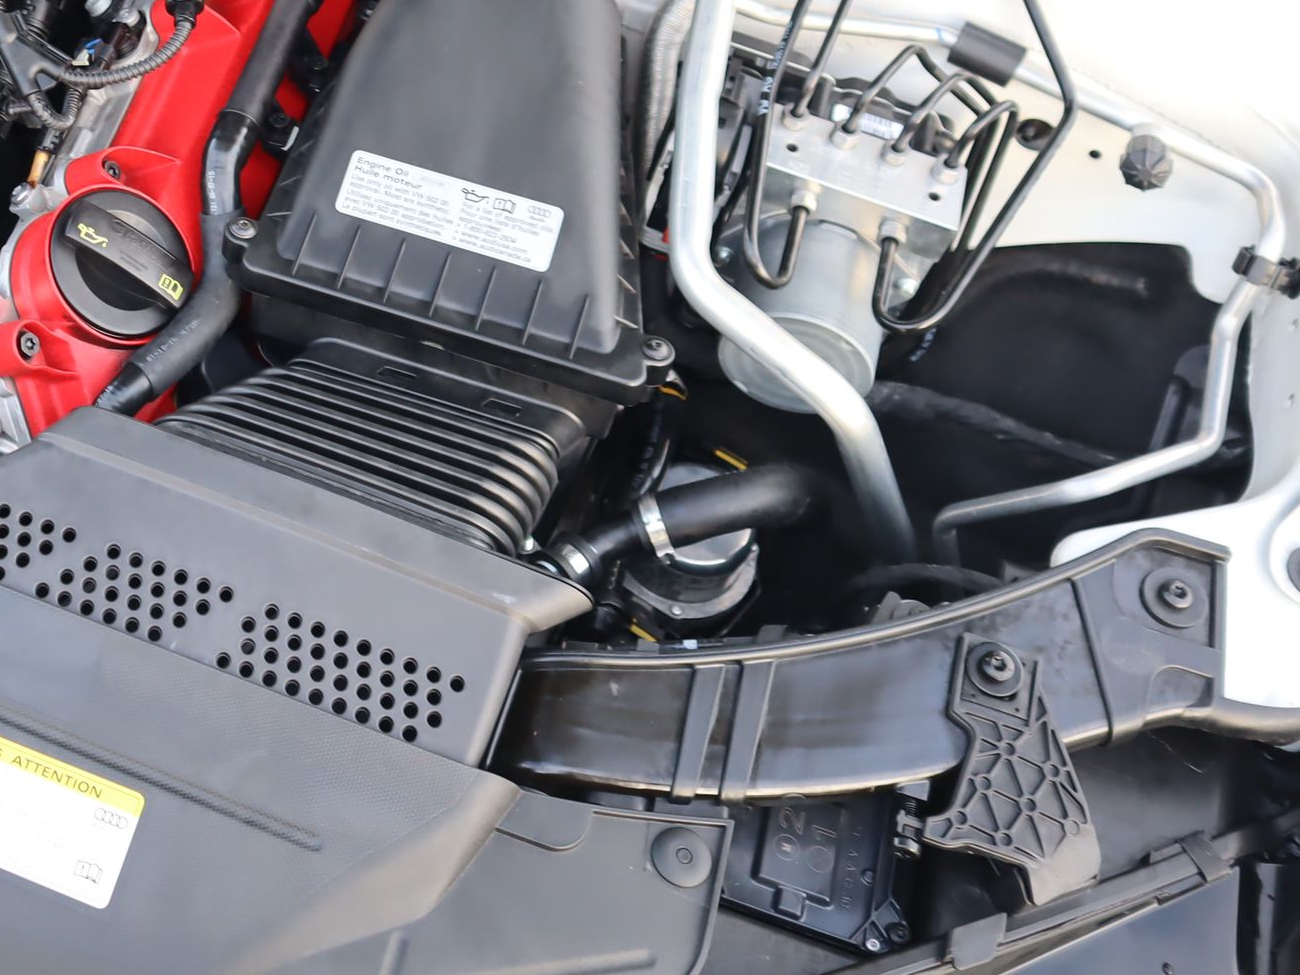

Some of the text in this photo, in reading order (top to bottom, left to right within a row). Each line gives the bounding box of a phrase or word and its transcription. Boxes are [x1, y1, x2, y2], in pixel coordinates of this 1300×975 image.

[354, 164, 380, 177] Huile
[382, 173, 422, 190] moteur
[356, 156, 409, 177] Engine Oil
[10, 754, 104, 800] ATTENTION
